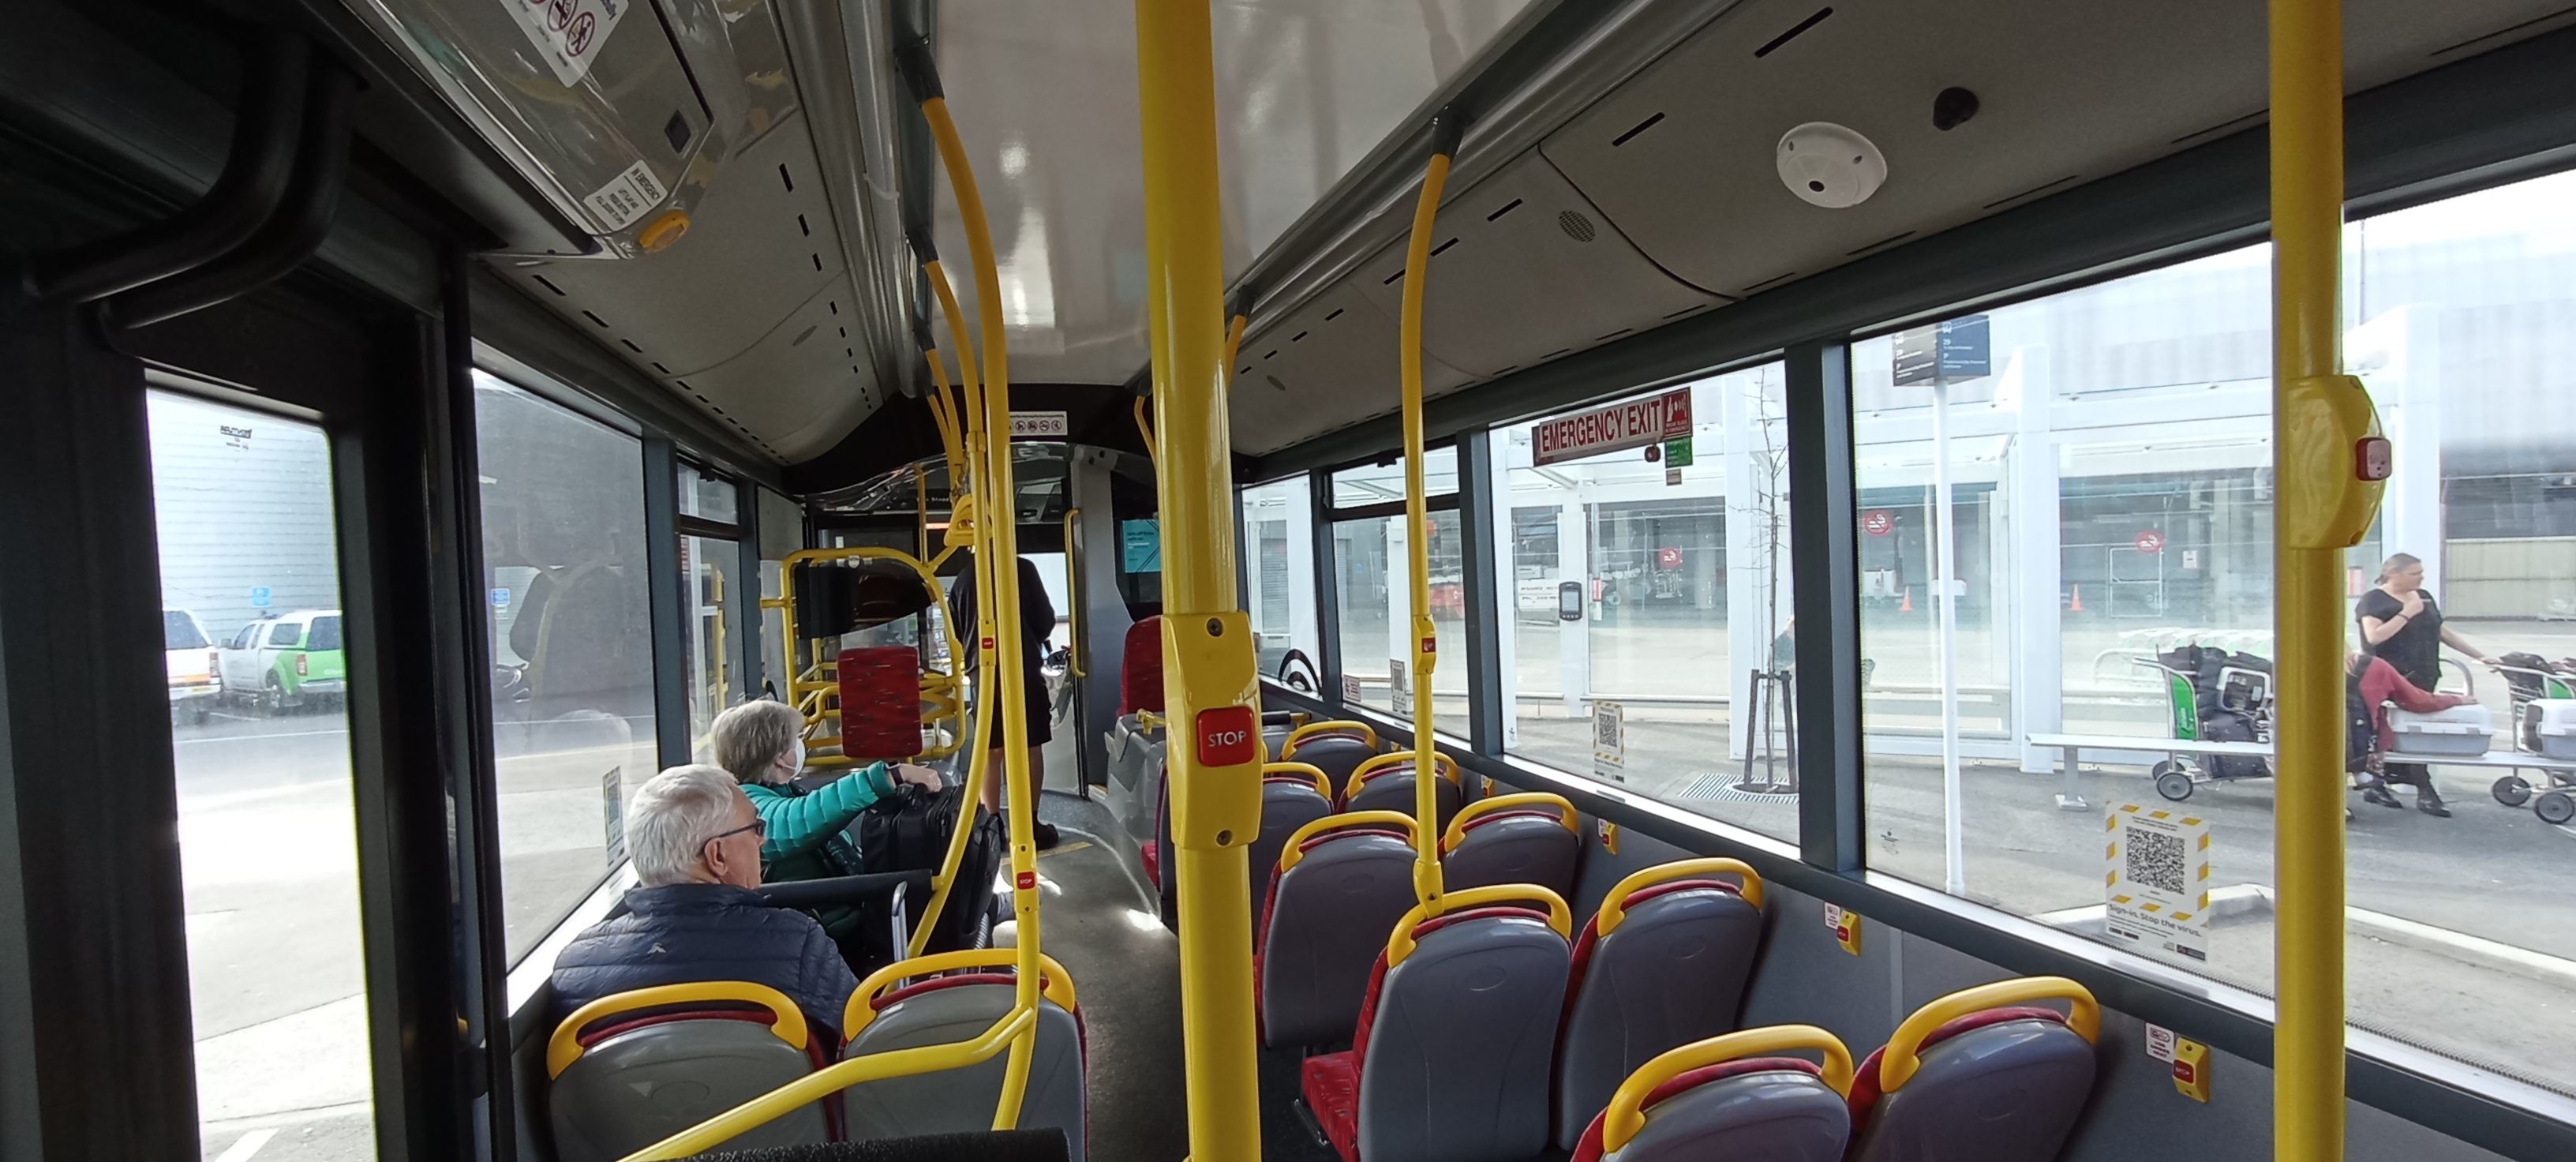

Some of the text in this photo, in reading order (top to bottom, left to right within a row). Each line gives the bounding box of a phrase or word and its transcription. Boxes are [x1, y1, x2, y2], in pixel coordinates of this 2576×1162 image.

[635, 173, 661, 201] EMERGENCY
[1542, 400, 1661, 452] EMERGENCY EXIT
[1208, 730, 1247, 748] STOP
[2109, 903, 2138, 919] Sign-in.
[2140, 913, 2159, 924] Stop
[2161, 919, 2176, 929] the
[2177, 924, 2202, 938] virus.
